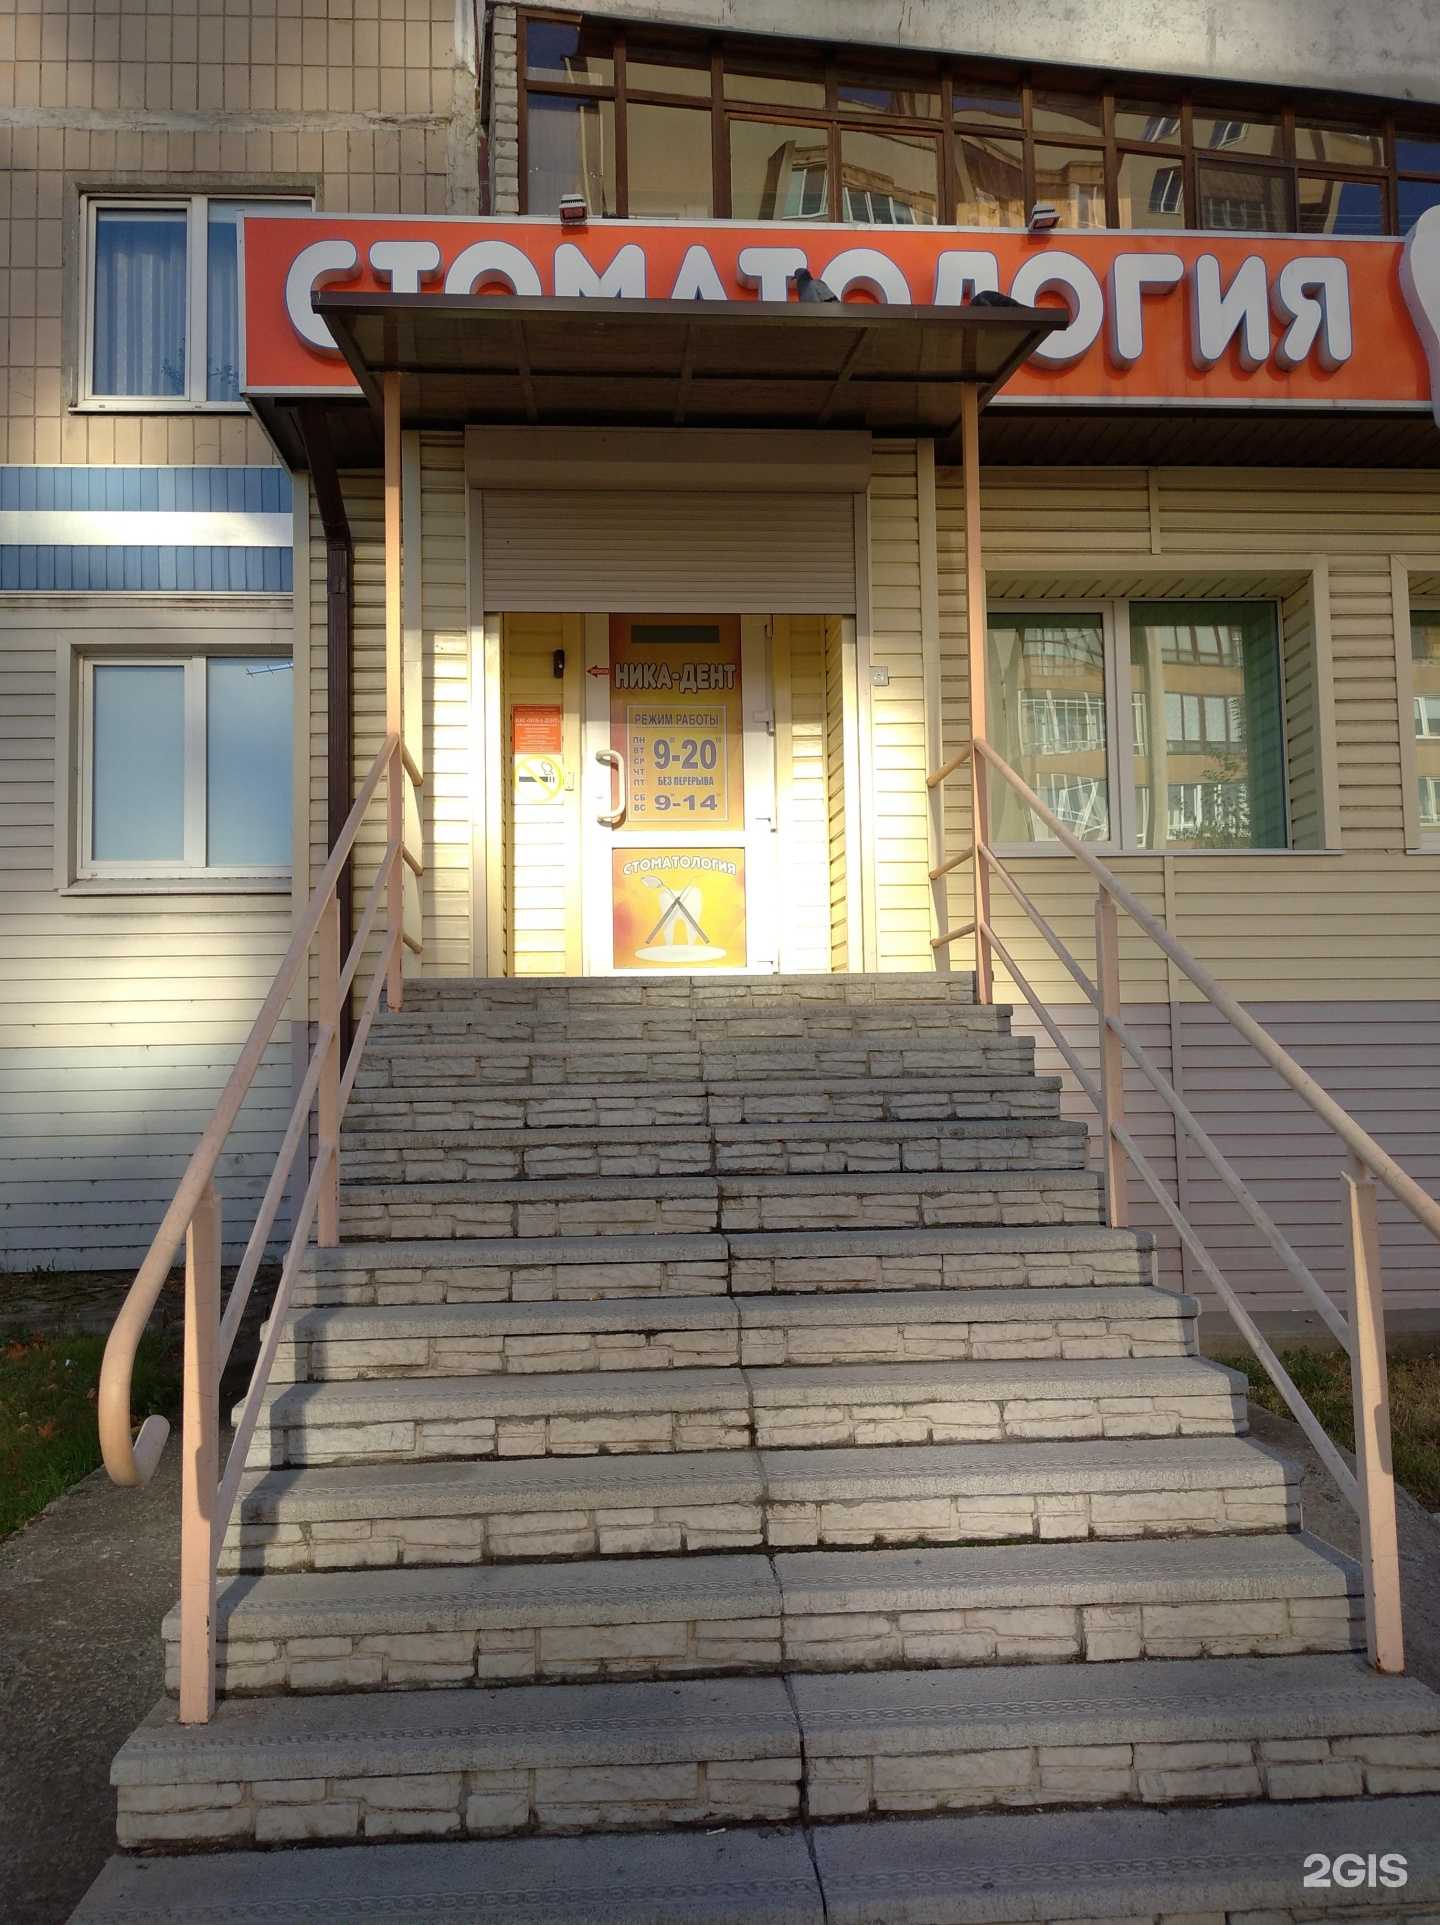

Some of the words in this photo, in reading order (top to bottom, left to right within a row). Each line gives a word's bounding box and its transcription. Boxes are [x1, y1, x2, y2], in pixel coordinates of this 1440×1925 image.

[615, 663, 736, 693] НИКА-ДЕНТ
[634, 713, 673, 726] РЕЖИМ
[676, 713, 719, 726] РАБОТЫ
[657, 776, 673, 786] БЕЗ
[674, 776, 714, 786] ПЕРЕРЫВА
[623, 856, 737, 875] СТОМАТОЛОГИЯ
